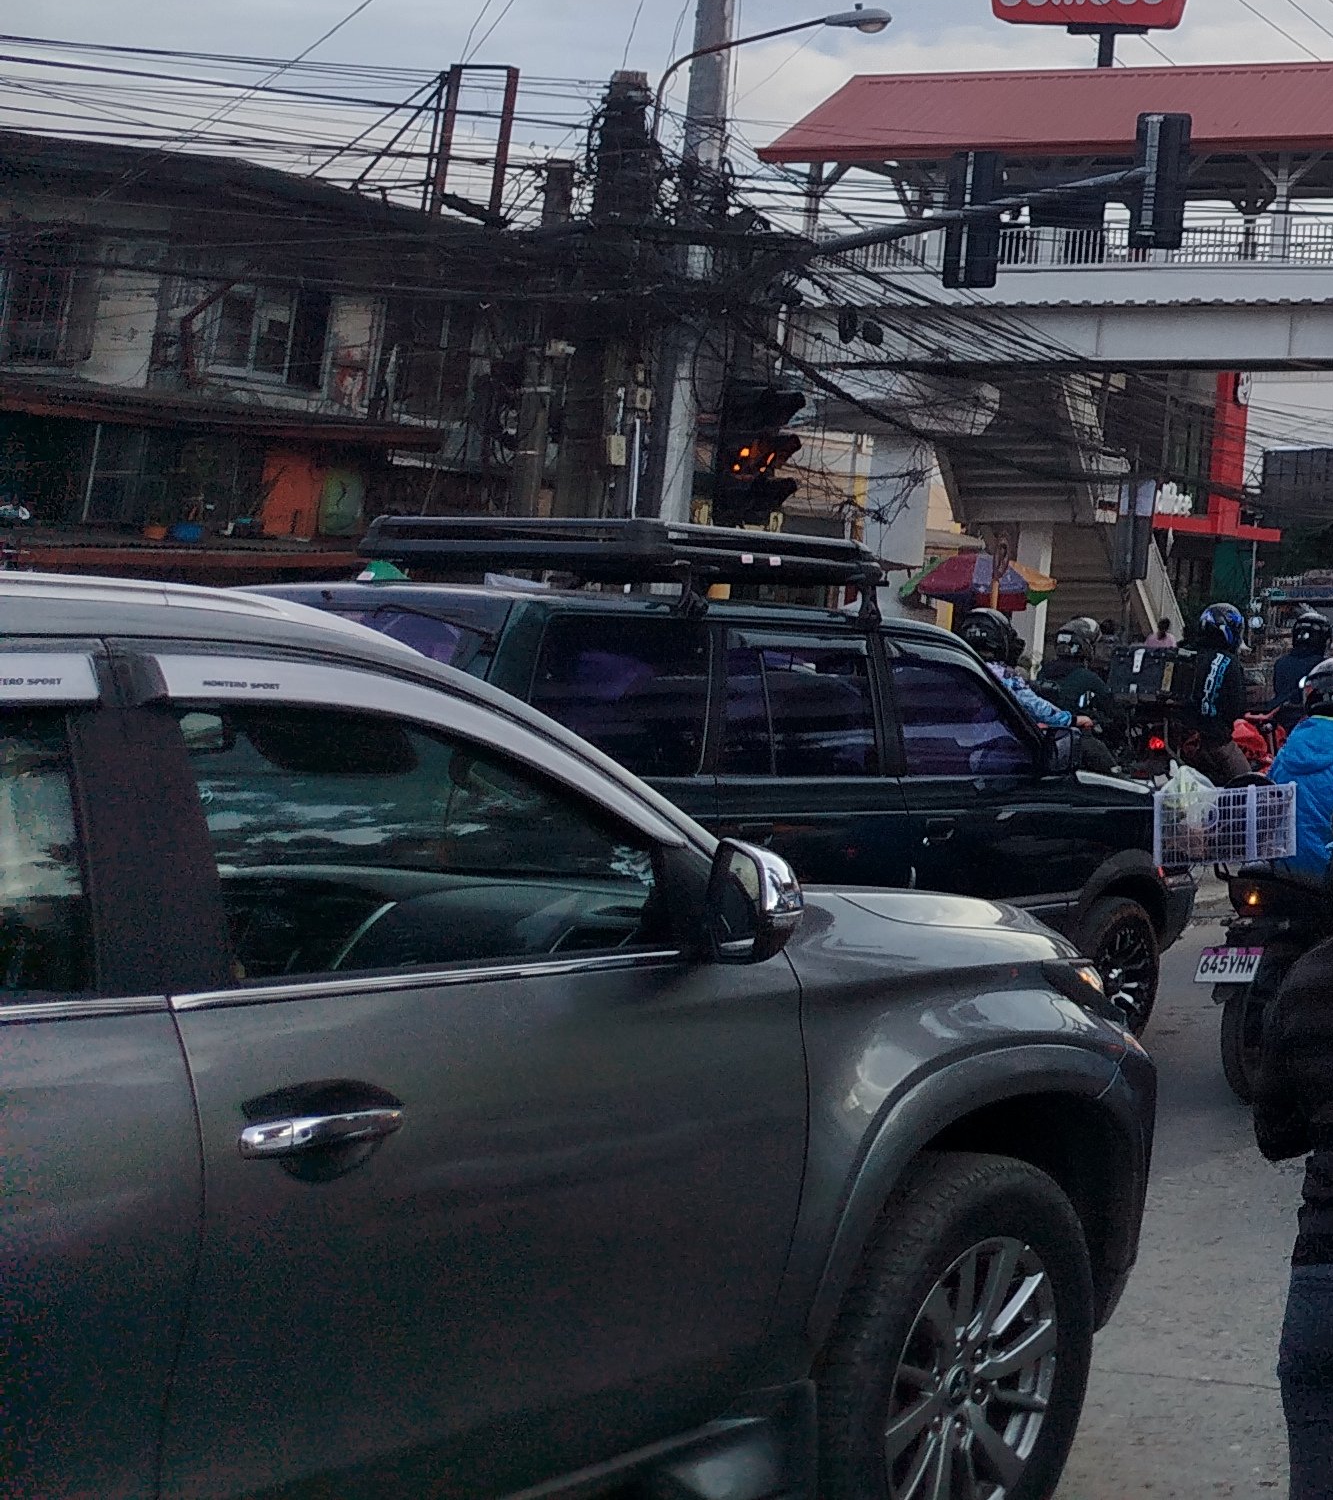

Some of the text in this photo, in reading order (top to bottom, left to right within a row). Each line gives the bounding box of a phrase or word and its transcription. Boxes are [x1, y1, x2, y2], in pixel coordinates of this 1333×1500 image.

[26, 677, 62, 686] SPORT
[202, 680, 280, 690] MONTERO SPORT
[1200, 956, 1258, 974] 645YHW
